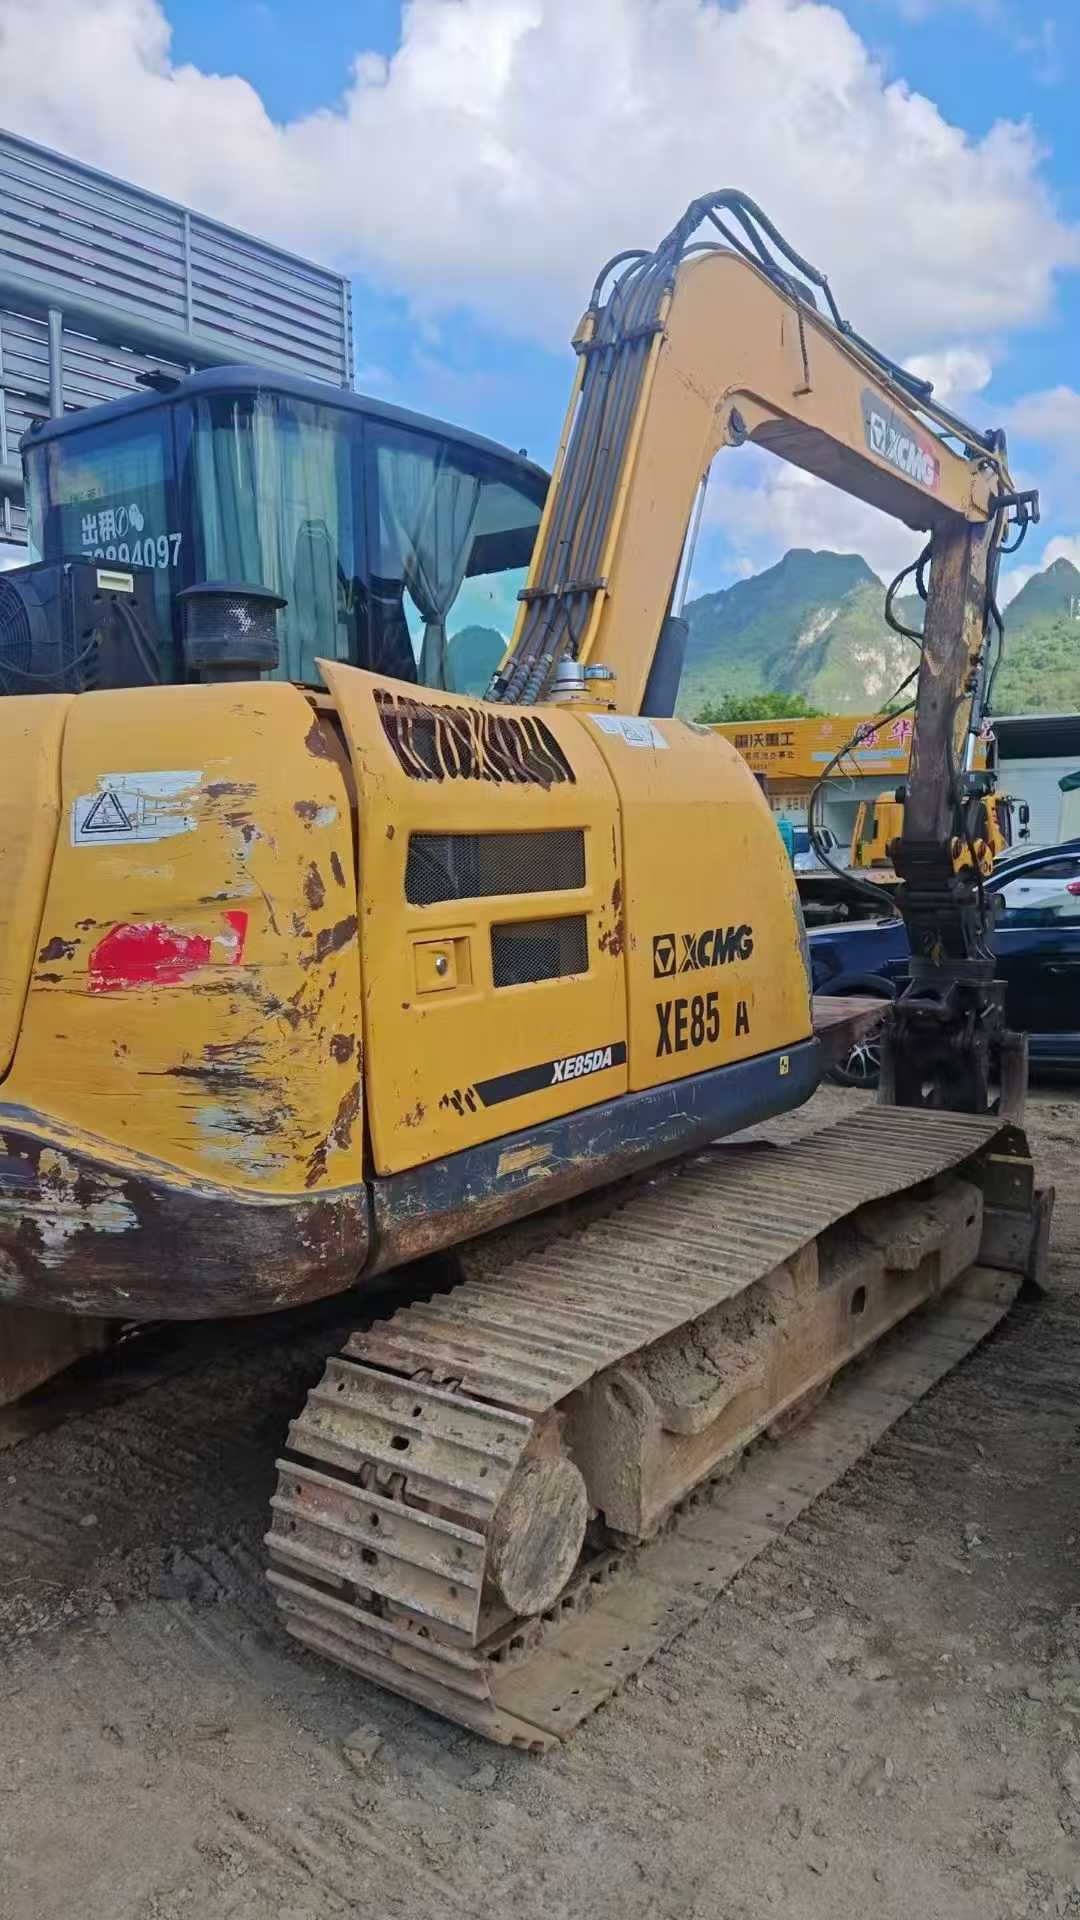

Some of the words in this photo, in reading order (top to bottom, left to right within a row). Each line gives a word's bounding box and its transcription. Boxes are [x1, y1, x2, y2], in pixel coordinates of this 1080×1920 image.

[886, 426, 935, 486] XCMG
[82, 509, 117, 545] 出租
[81, 532, 182, 569] 94097
[678, 924, 754, 973] XCMG
[655, 992, 720, 1058] XE85
[735, 1000, 750, 1037] A
[551, 1046, 613, 1085] XE85DA
